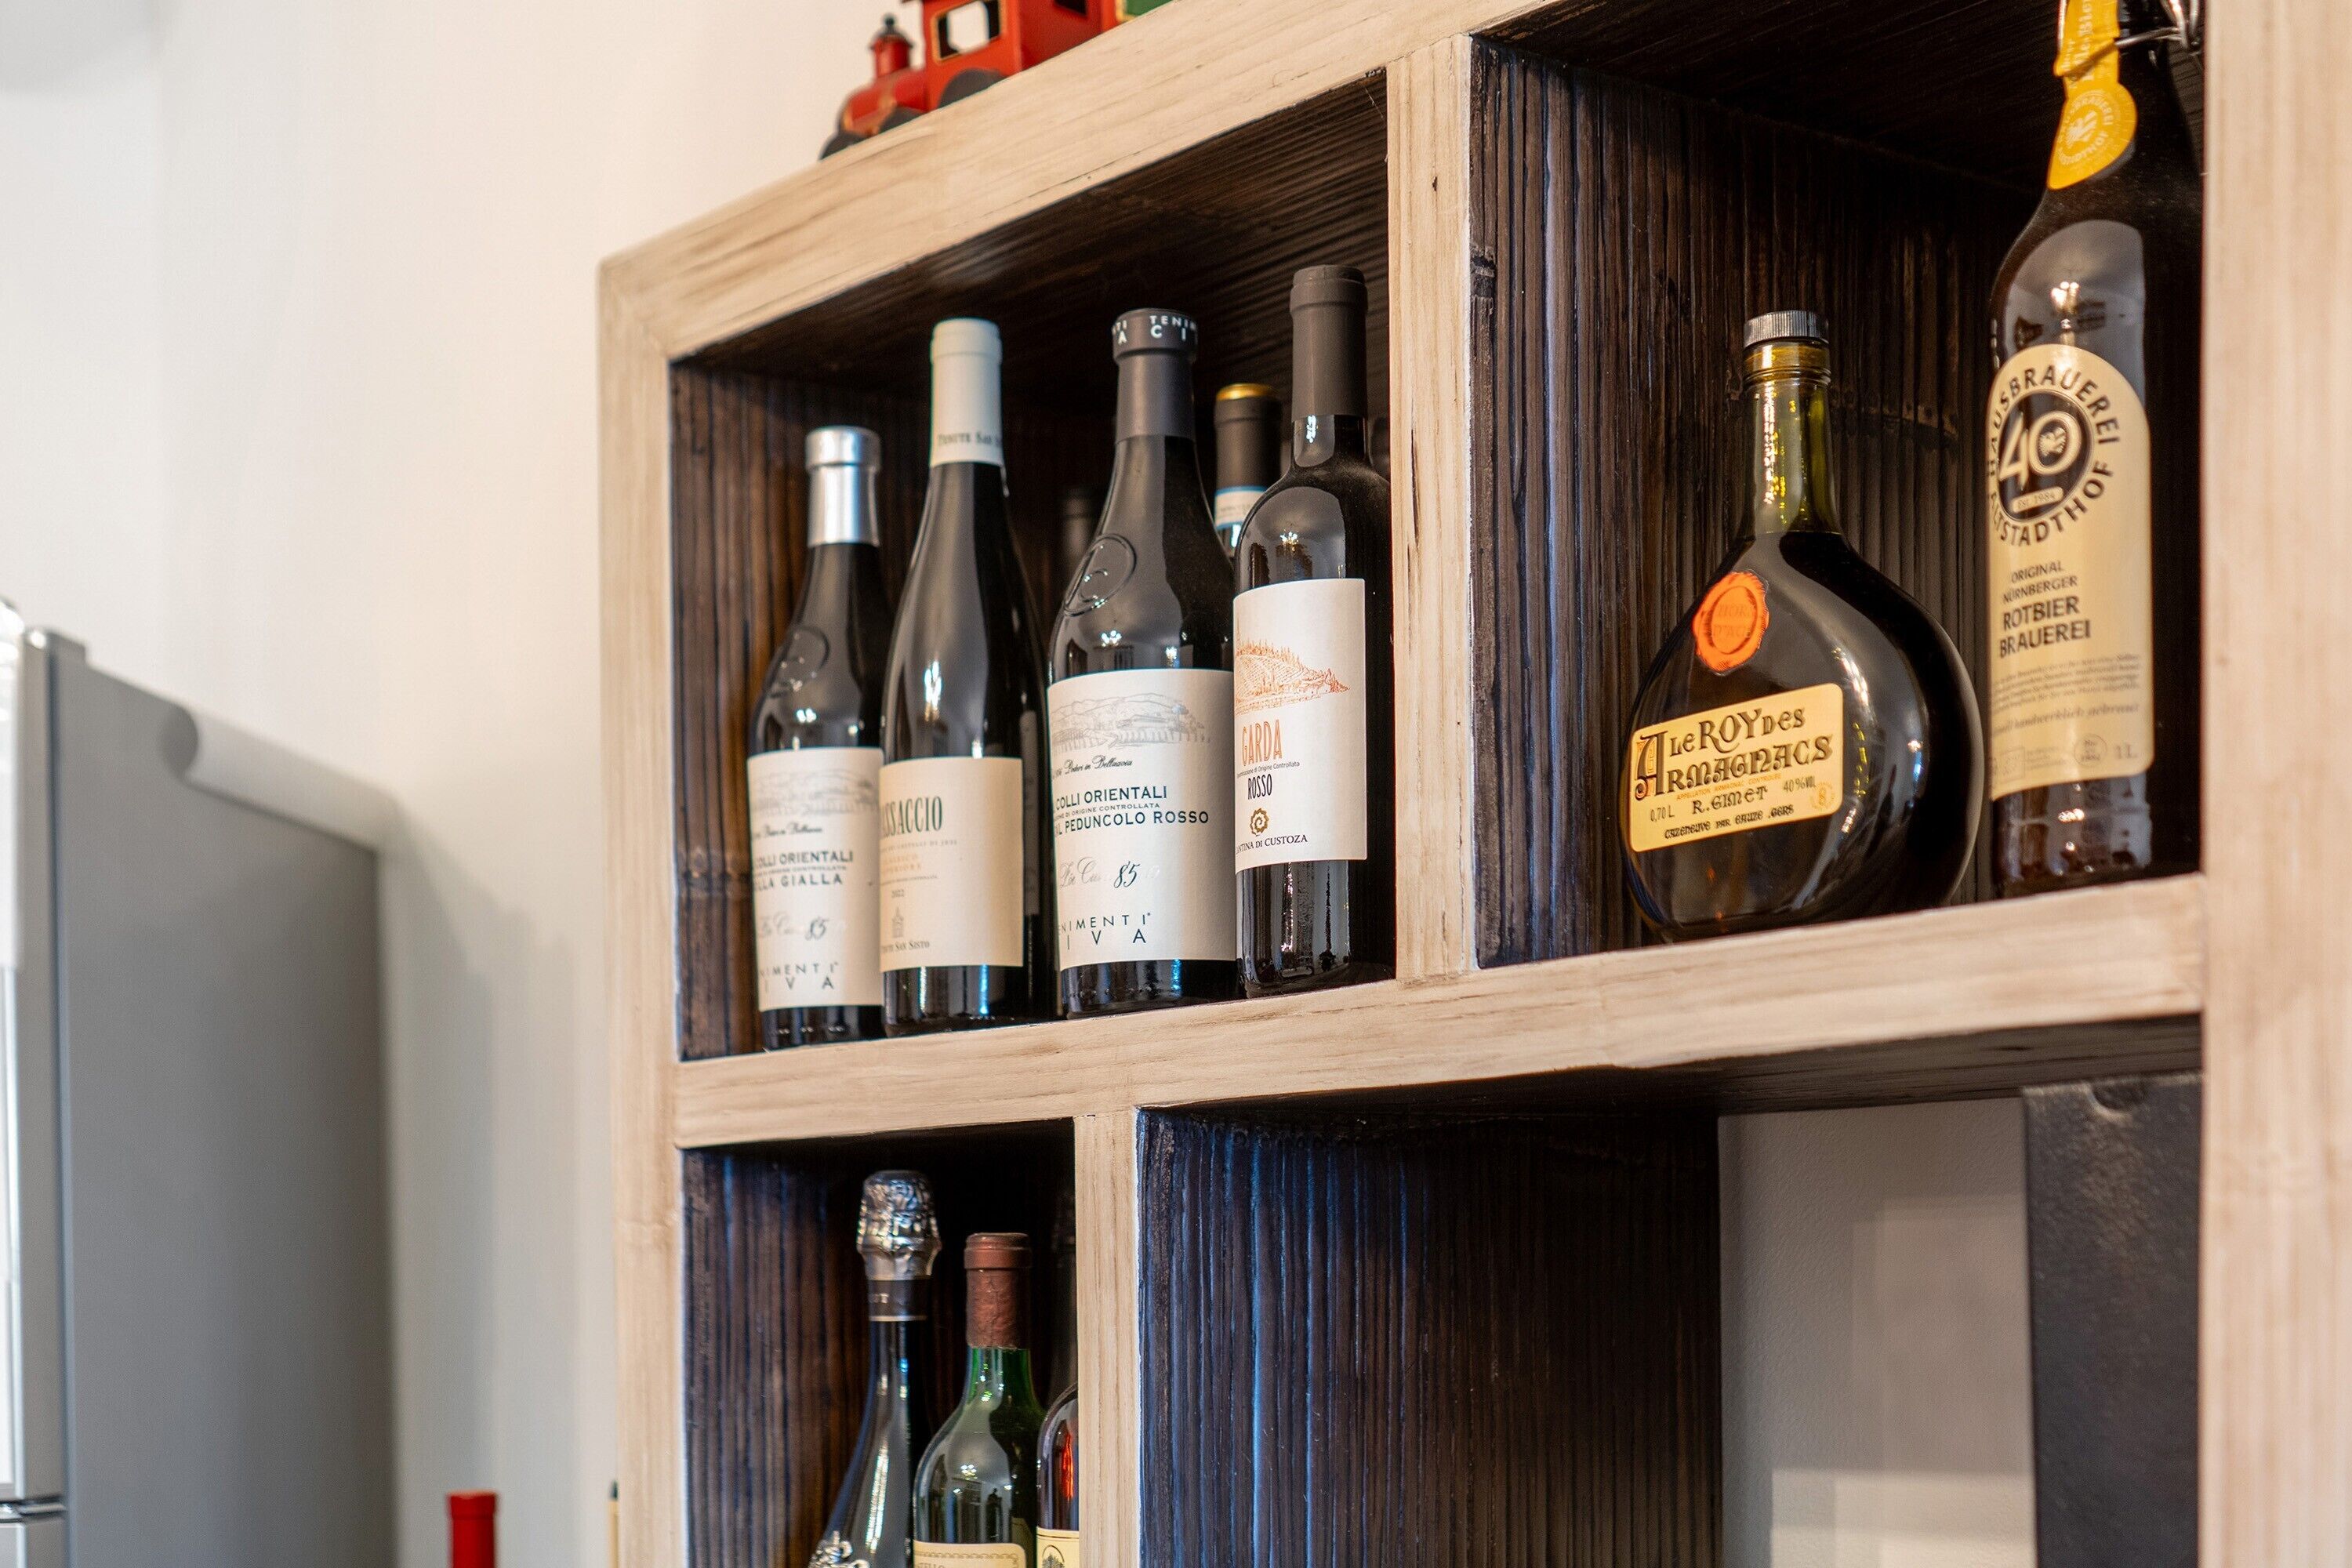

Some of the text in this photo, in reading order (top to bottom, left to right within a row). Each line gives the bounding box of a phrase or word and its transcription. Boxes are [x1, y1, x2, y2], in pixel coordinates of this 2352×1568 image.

[1999, 409, 2082, 492] 40
[2012, 560, 2064, 583] ORIGINAL
[2003, 595, 2080, 631] ROTBIER
[1999, 619, 2092, 659] BRAUEREI
[1242, 719, 1283, 767] GARDA
[1056, 786, 1167, 811] COLLI ORIENTALI
[1247, 773, 1272, 800] ROSSO
[1065, 811, 1145, 833] PEDUNCOLO
[1153, 811, 1208, 824] ROSSO
[1071, 807, 1097, 816] ORIGINE
[1098, 803, 1160, 811] CONTROLLATA
[1264, 834, 1308, 846] CUSTOZA
[779, 851, 854, 865] ORIENTALI
[781, 873, 843, 887] GIALLA
[1113, 861, 1141, 889] 85
